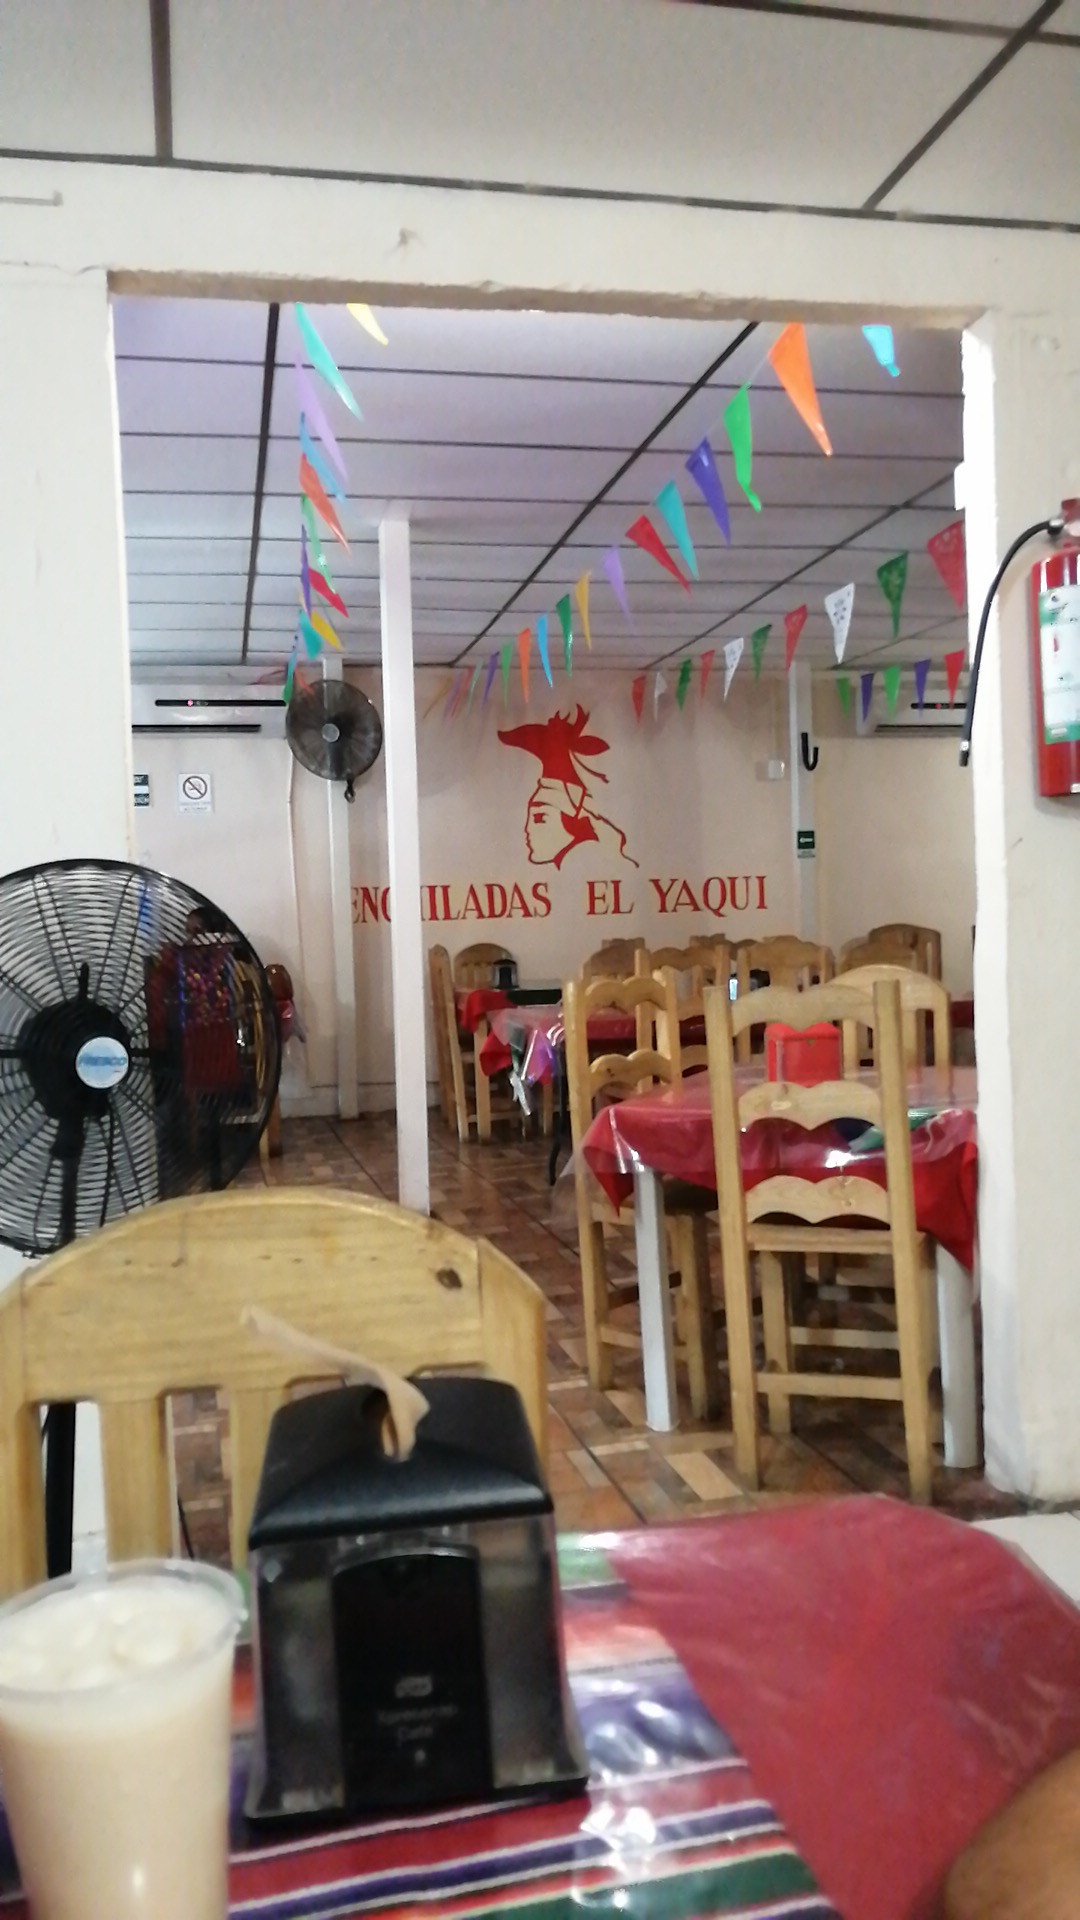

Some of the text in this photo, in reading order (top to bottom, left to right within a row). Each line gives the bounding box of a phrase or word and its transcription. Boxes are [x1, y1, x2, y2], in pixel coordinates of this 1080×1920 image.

[351, 875, 768, 924] ENILADAS EL YAQUI
